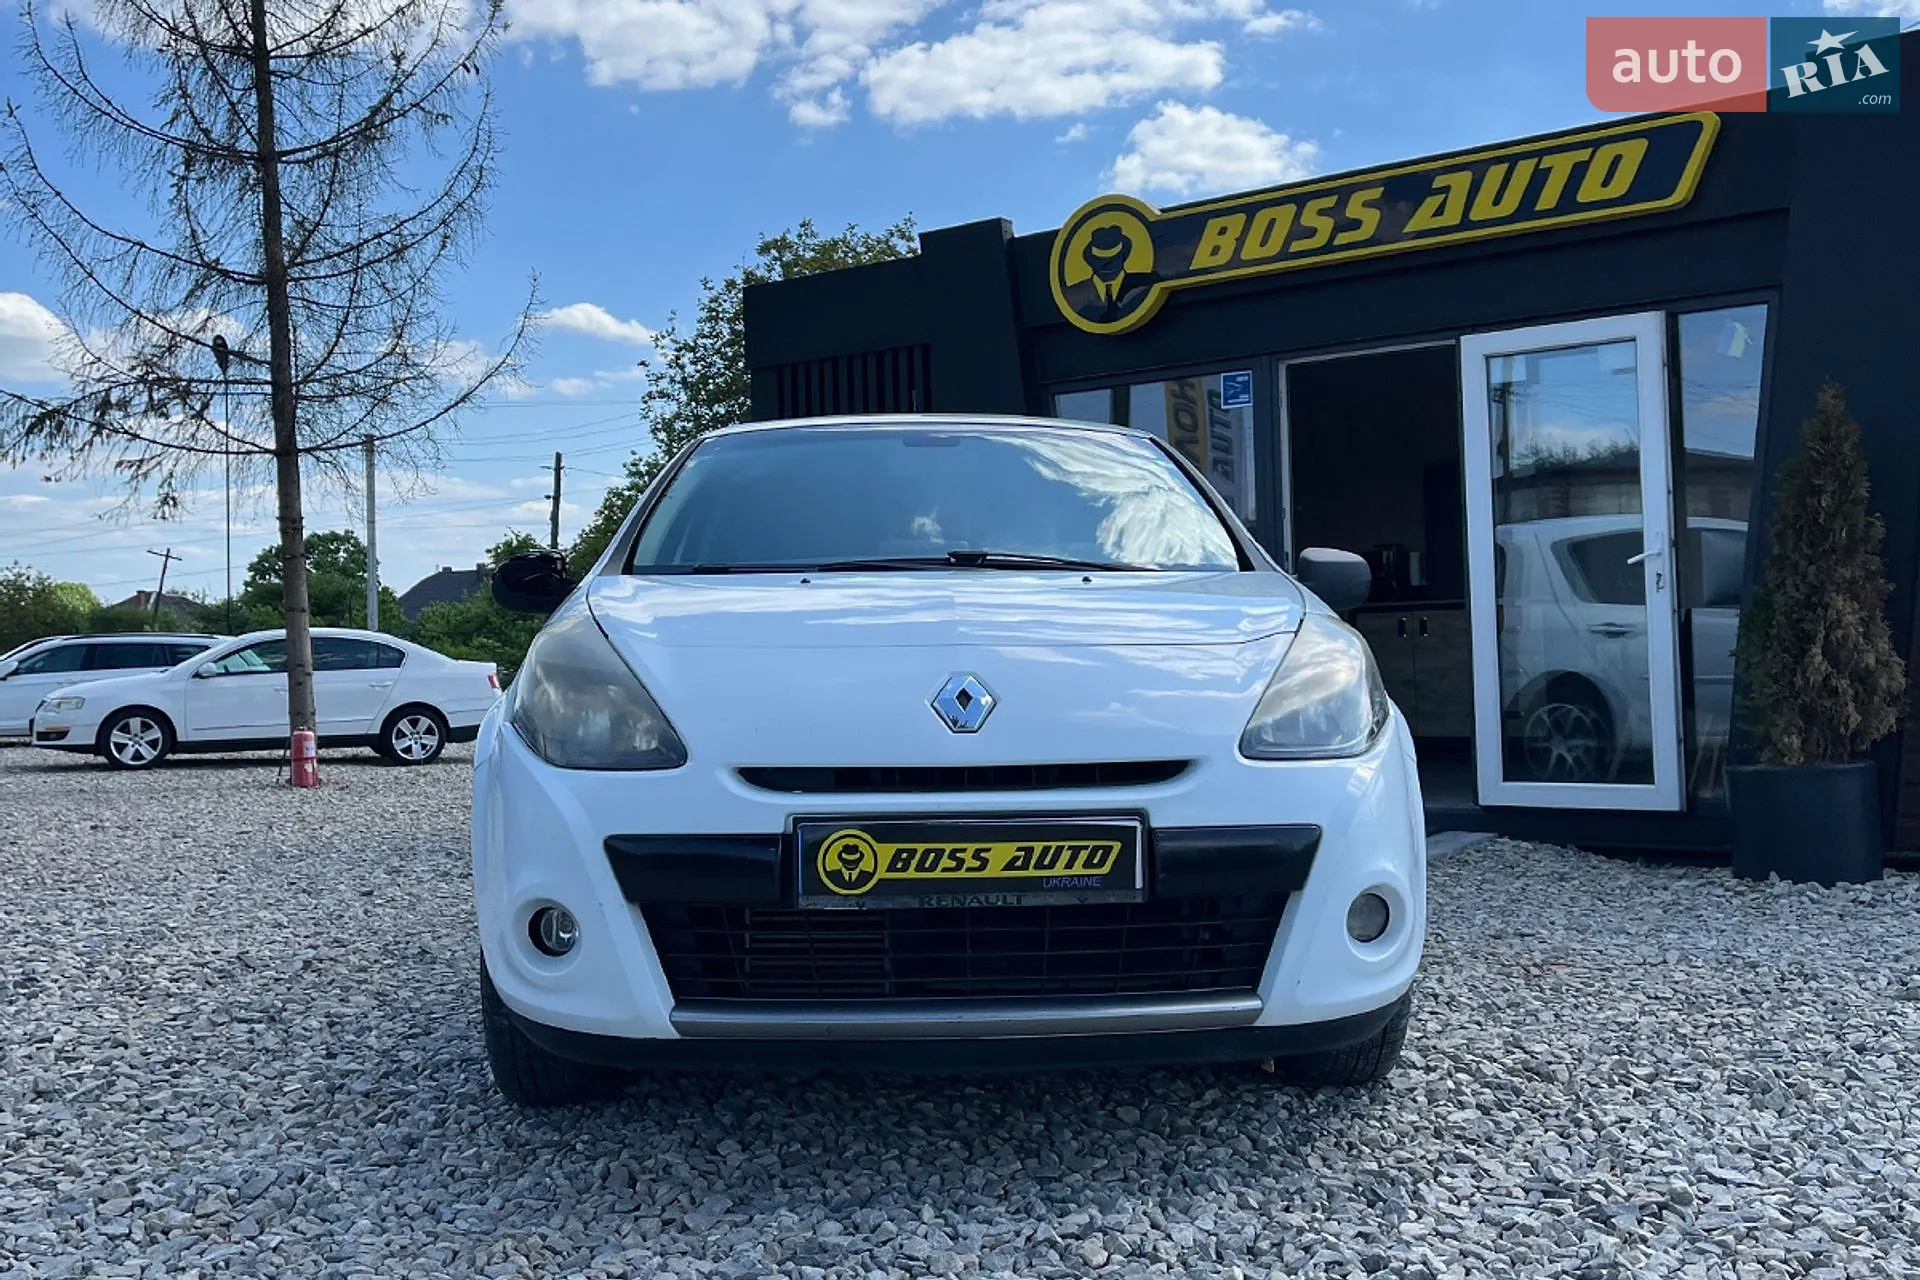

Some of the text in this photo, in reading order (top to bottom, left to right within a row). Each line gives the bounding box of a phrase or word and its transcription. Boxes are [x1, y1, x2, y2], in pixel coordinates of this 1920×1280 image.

[1189, 138, 1649, 270] BOSS AUTO
[885, 845, 1115, 873] BOSS AUTO
[1042, 876, 1102, 888] UKRAINE
[917, 893, 1027, 909] RENAULT
